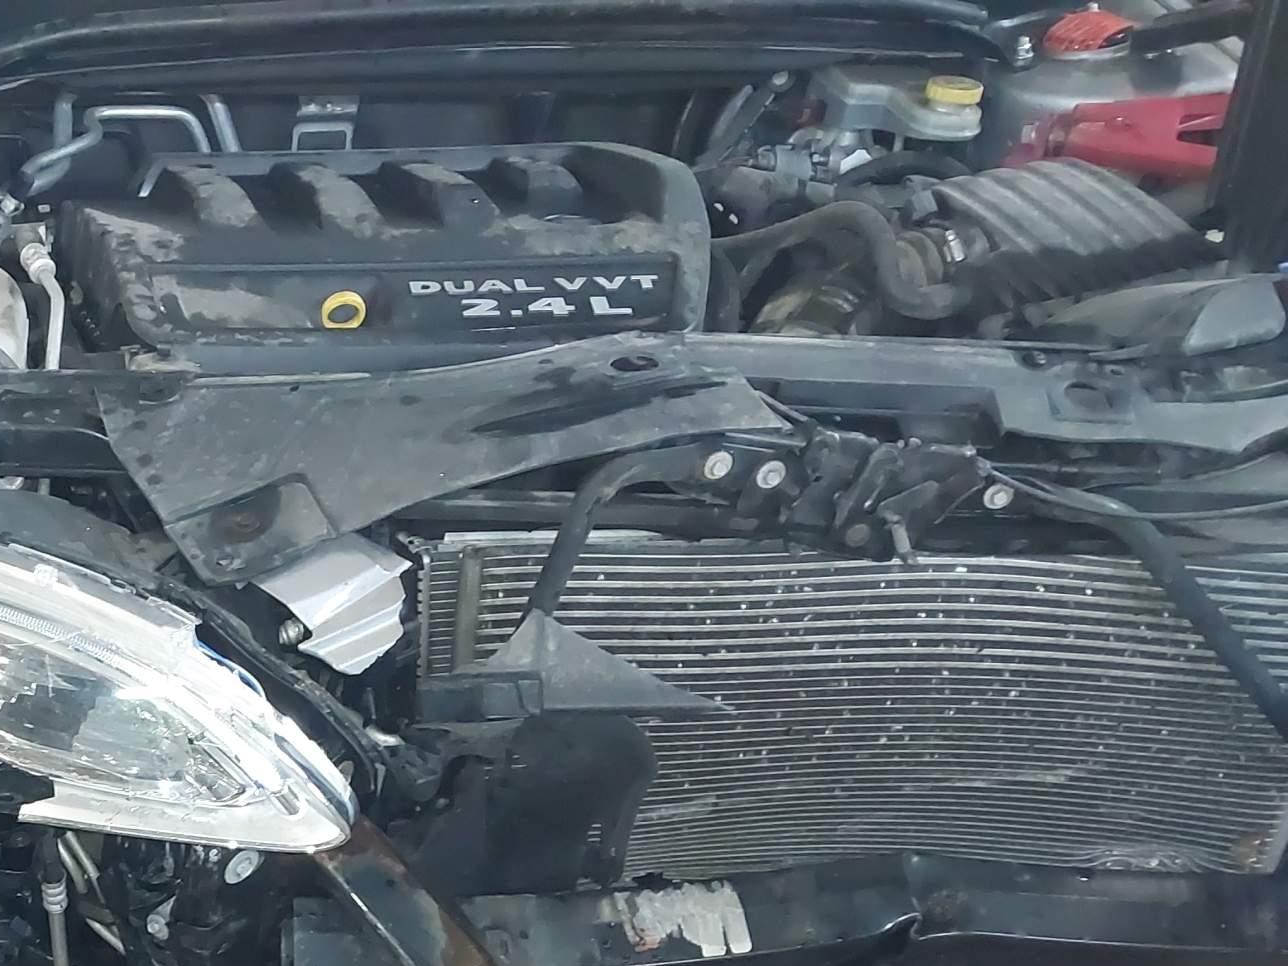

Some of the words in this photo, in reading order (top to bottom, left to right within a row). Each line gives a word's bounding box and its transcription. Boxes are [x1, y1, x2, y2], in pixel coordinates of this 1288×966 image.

[409, 278, 545, 294] DUAL
[553, 274, 659, 291] VVT
[461, 297, 575, 317] 2.4
